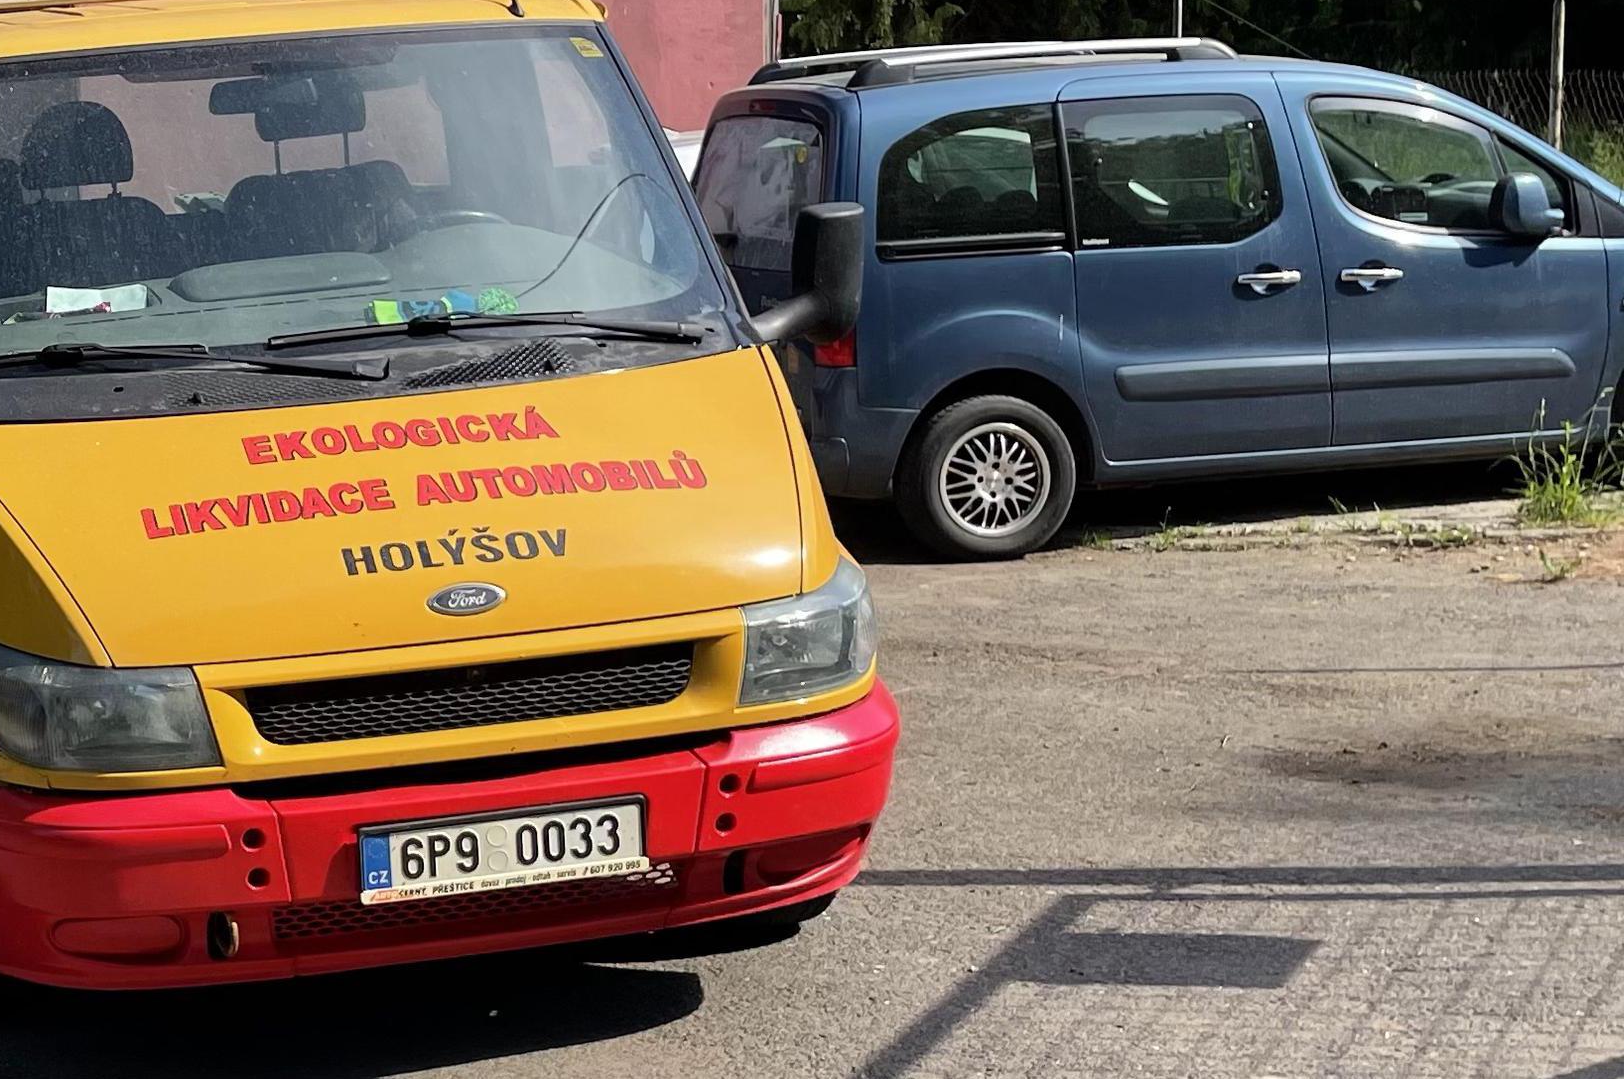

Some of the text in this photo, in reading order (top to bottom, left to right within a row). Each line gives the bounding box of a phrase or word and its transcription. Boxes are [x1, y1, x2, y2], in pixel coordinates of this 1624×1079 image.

[241, 405, 561, 465] EKOLOGICKÁ
[140, 449, 707, 540] LIKVIDACE AUTOMOBILŮ
[342, 525, 567, 576] HOLÝŠOV
[448, 588, 487, 608] Ford
[400, 813, 621, 879] 6P9 0033
[590, 864, 605, 874] 607
[368, 869, 389, 885] CZ
